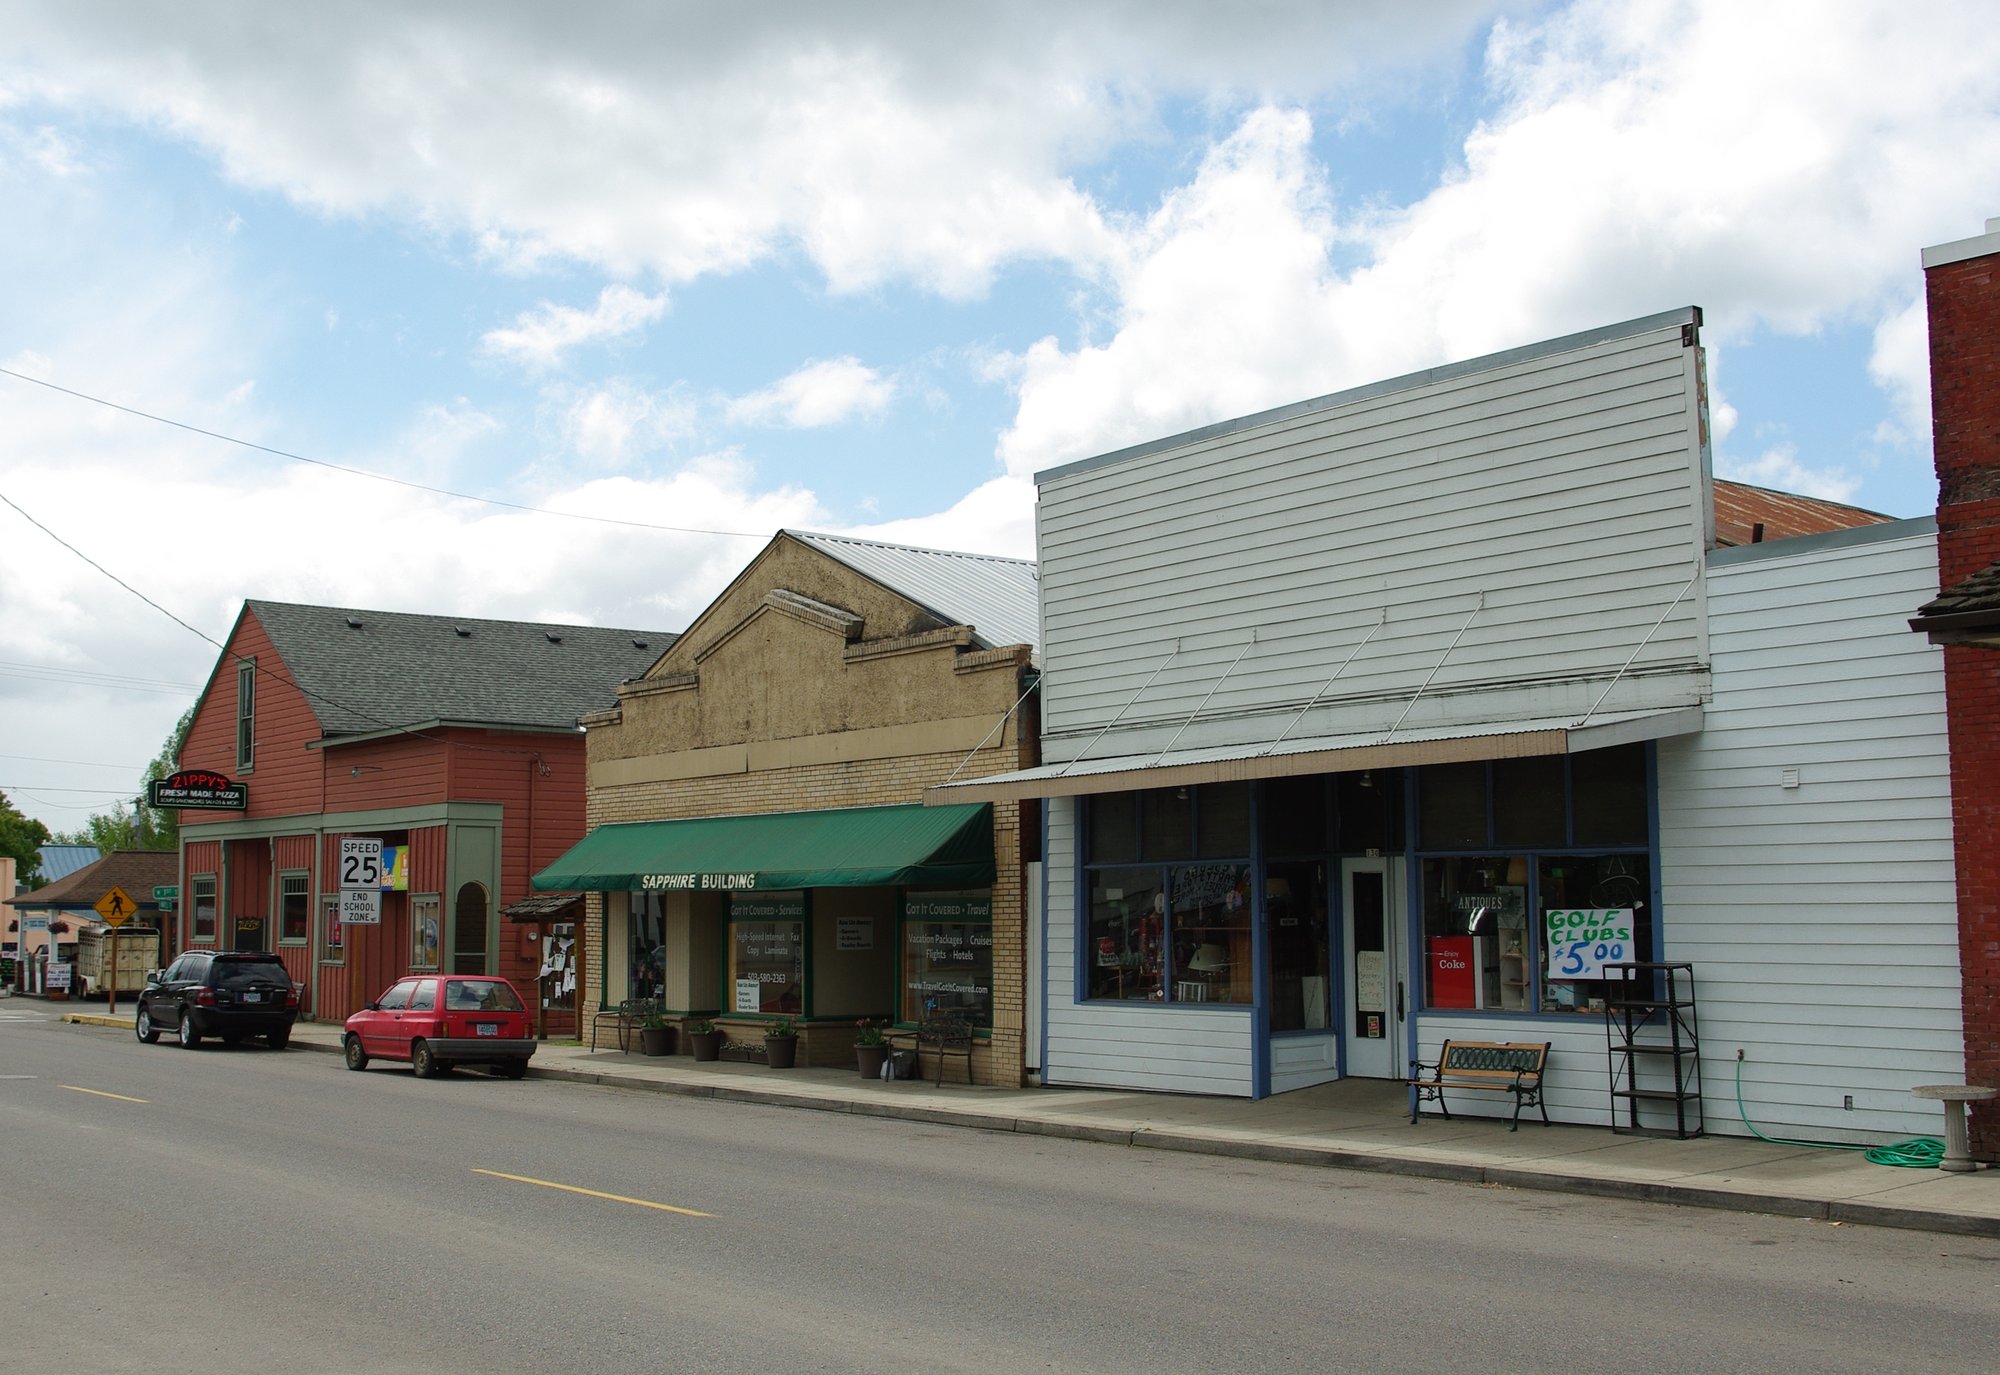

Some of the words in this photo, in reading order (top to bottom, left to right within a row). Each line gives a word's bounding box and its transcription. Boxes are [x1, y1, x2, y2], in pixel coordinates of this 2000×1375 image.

[171, 774, 227, 790] ZIPPY'S
[160, 789, 187, 797] FRESH
[190, 790, 213, 798] MADE
[215, 791, 240, 799] PIZZA
[343, 842, 380, 854] SPEED
[343, 855, 378, 884] 25
[642, 873, 696, 889] SAPPHIRE
[701, 873, 756, 889] BUILDING
[352, 892, 368, 901] END
[343, 902, 375, 912] SCHOOL
[967, 903, 990, 915] Travel
[1457, 896, 1503, 910] ANTIQUES
[778, 904, 803, 916] Services
[348, 913, 370, 922] ZONE
[1547, 910, 1621, 930] GOLF
[736, 932, 764, 943] High-Speed
[764, 932, 785, 941] Internet
[790, 932, 800, 941] Fax
[908, 933, 935, 943] Vacation
[935, 934, 963, 947] Packages
[969, 935, 992, 946] Cruises
[1550, 927, 1631, 946] CLUBS
[746, 945, 760, 956] Copy
[764, 945, 789, 955] Laminate
[926, 949, 946, 961] Flights
[952, 949, 974, 961] Hotels
[1443, 950, 1459, 959] Enjoy
[1439, 959, 1466, 970] Coke
[747, 972, 786, 984] 503-580-2363
[908, 981, 988, 994] www.TravelGotItCovered.com
